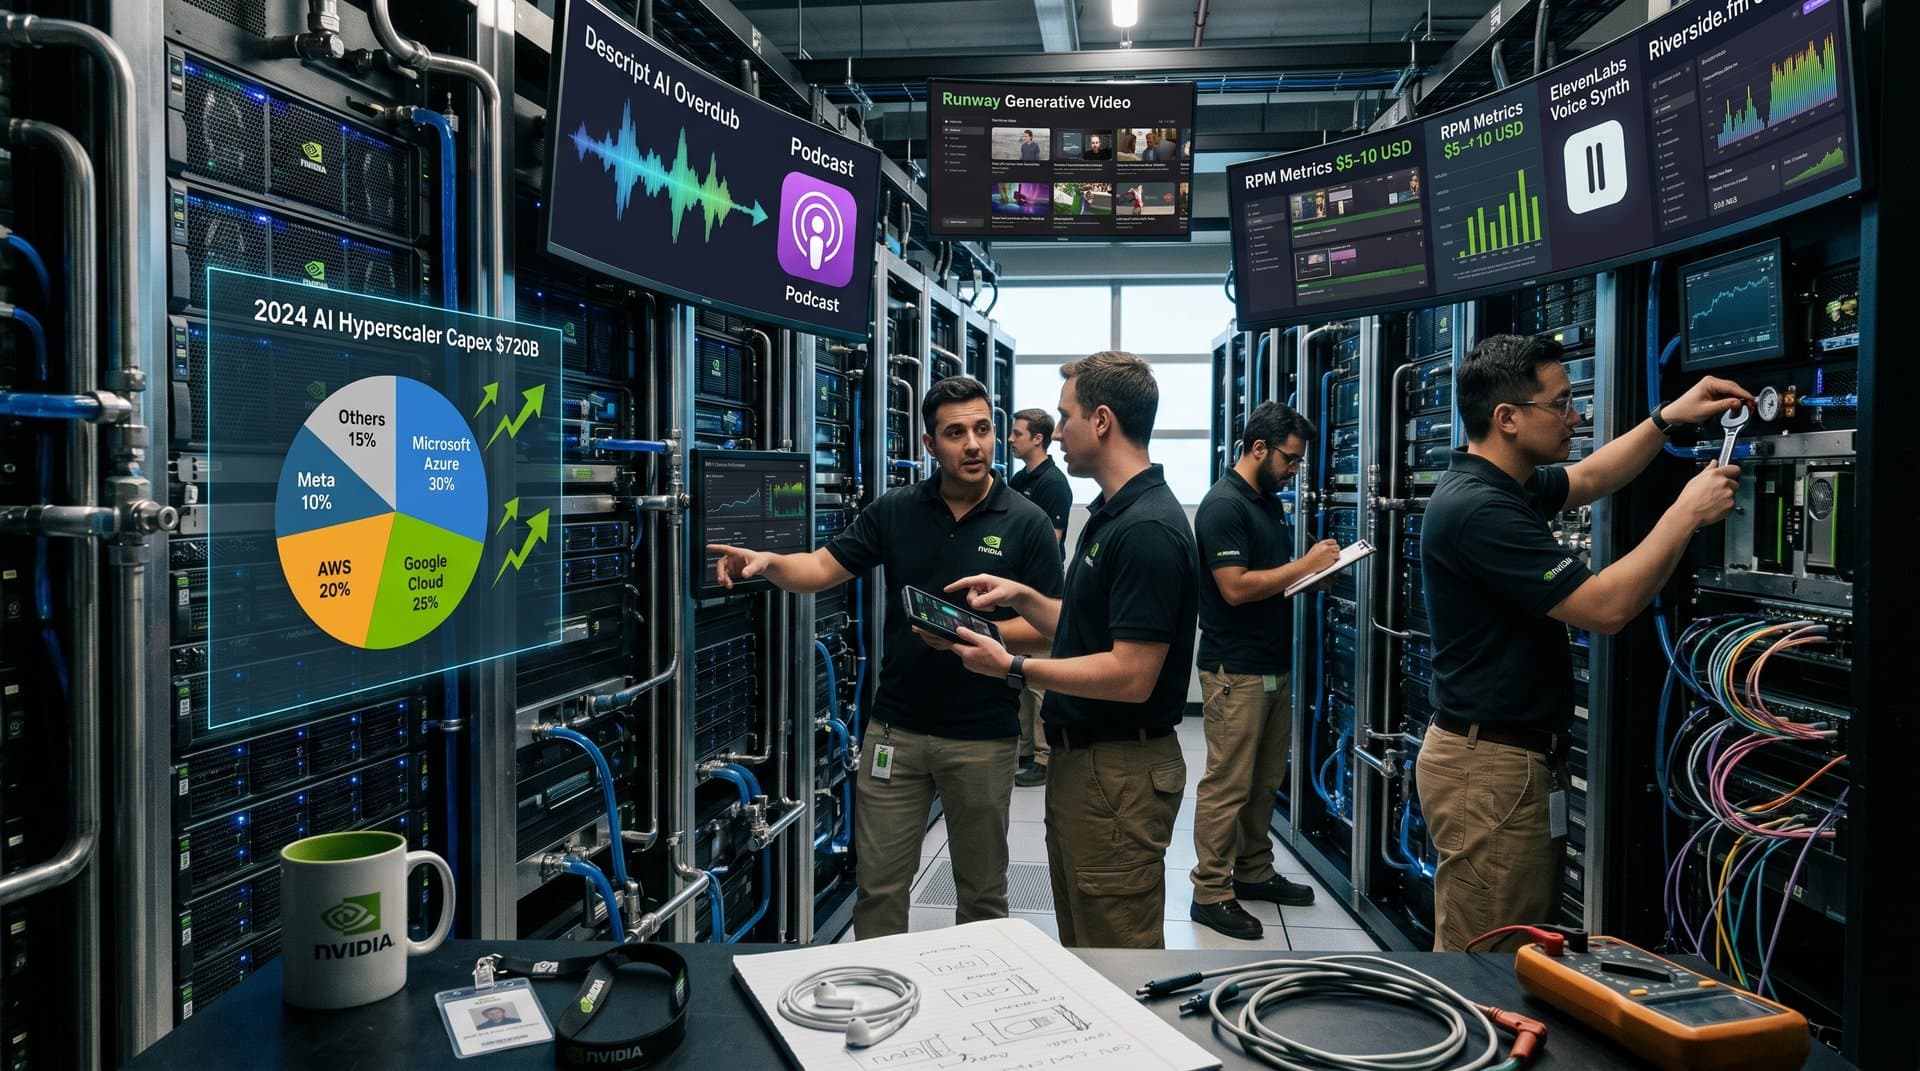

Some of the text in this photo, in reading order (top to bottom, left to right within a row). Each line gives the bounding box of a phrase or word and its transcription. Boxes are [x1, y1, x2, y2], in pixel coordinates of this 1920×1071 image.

[585, 25, 740, 130] Descript AI Overdub
[1550, 57, 1627, 101] ElevenLabs
[942, 91, 1131, 111] Runway Generative Video
[1550, 77, 1630, 121] Voice Synth
[1441, 102, 1523, 140] RPM Metrics
[1495, 120, 1524, 142] USD
[791, 137, 854, 178] Podcast
[1245, 171, 1276, 189] RPM
[1280, 161, 1333, 183] Metrics
[1381, 140, 1412, 160] USD
[785, 285, 840, 313] Podcast
[254, 299, 540, 358] 2024 AI Hyperscaler Capex $720B
[338, 409, 386, 426] Others
[348, 432, 377, 448] 15%
[412, 436, 471, 452] Microsoft
[424, 457, 460, 471] Azure
[297, 472, 335, 487] Meta
[428, 476, 455, 491] 30%
[301, 495, 332, 510] 10%
[318, 560, 351, 577] AWS
[404, 554, 447, 572] Google
[319, 582, 350, 599] 20%
[408, 574, 443, 591] Cloud
[413, 596, 439, 611] 25%
